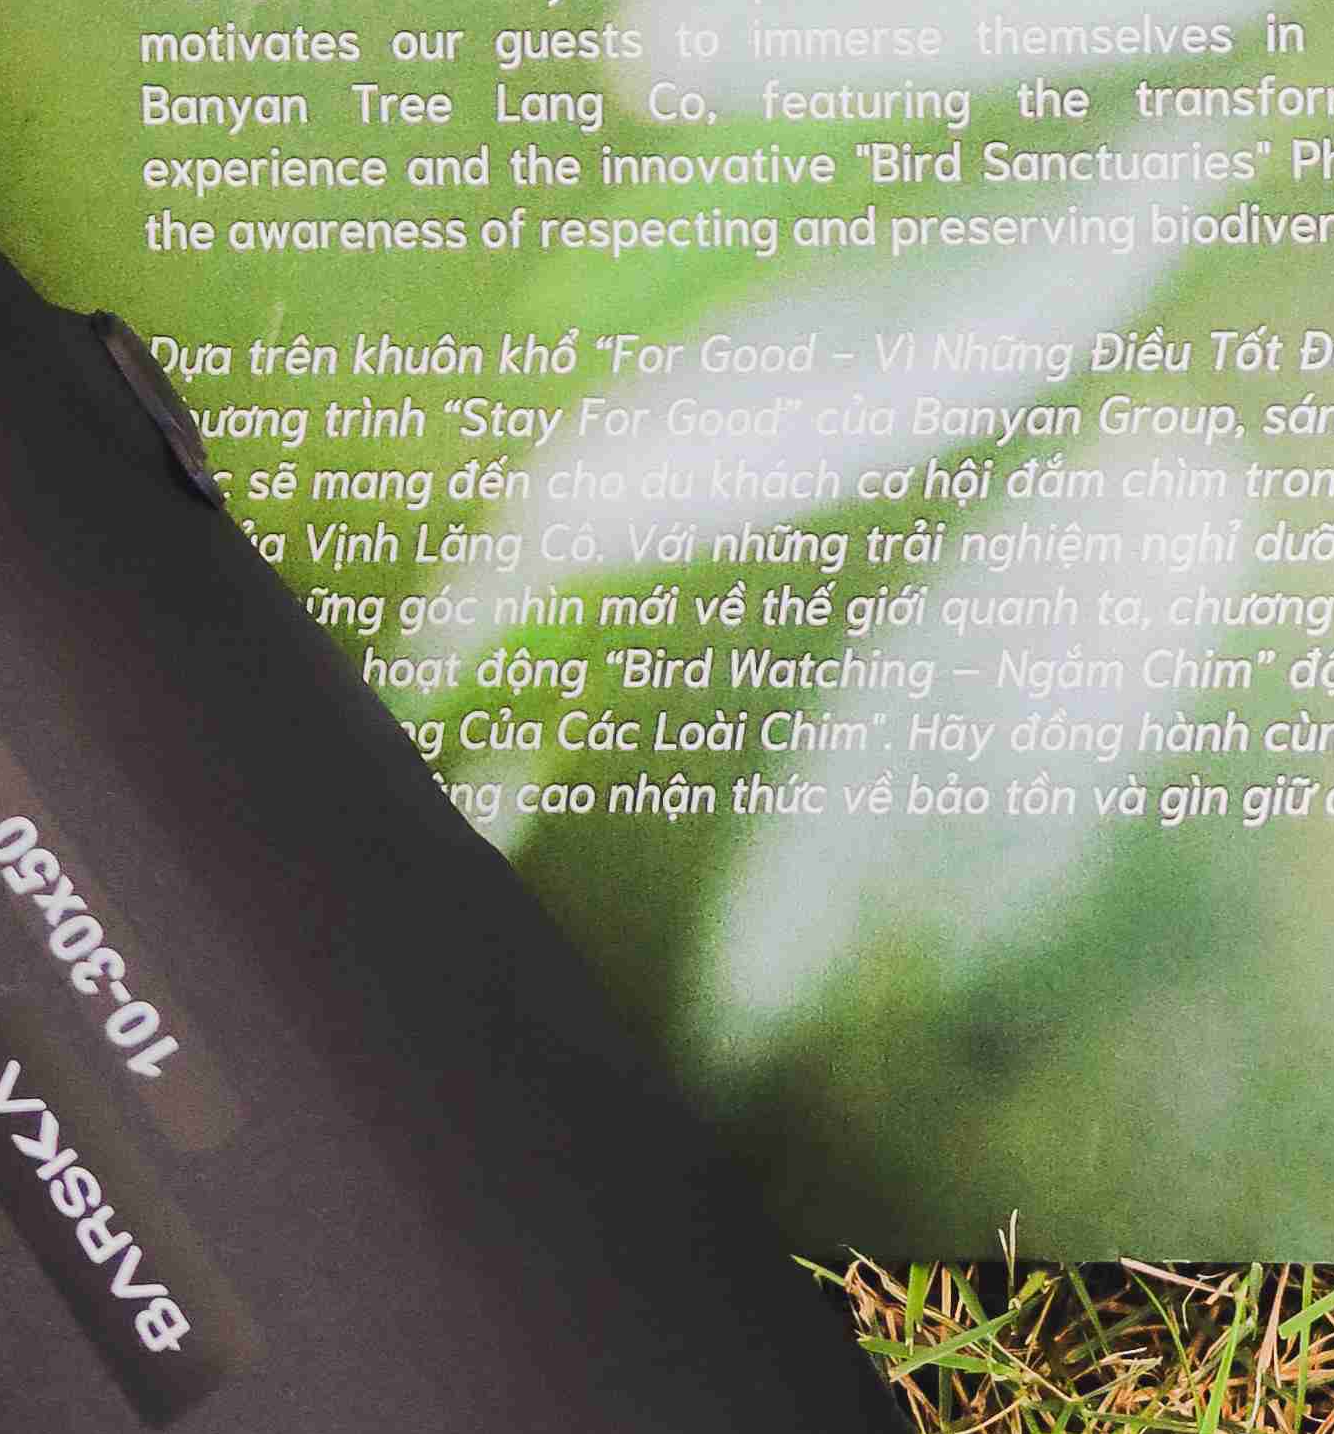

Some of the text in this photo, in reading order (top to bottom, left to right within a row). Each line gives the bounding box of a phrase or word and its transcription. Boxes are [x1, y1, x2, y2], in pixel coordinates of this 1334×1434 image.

[138, 21, 362, 65] motivates
[388, 30, 465, 64] our
[493, 23, 644, 73] guests
[674, 21, 721, 62] to
[745, 14, 944, 61] immerse
[969, 12, 1235, 57] themselves
[1265, 12, 1306, 55] in
[140, 83, 309, 137] Banyan
[349, 82, 454, 127] Tree
[494, 82, 605, 136] Lang
[647, 81, 718, 127] Co,
[761, 77, 972, 135] featuring
[1015, 76, 1091, 121] the
[141, 146, 388, 200] experience
[404, 143, 491, 191] and
[508, 143, 582, 188] the
[600, 142, 837, 187] innovative
[143, 208, 216, 253] the
[227, 218, 469, 254] awareness
[479, 206, 527, 252] of
[538, 205, 780, 262] respecting
[791, 203, 878, 251] and
[889, 204, 1136, 259] preserving
[147, 333, 235, 386] Dựa
[248, 329, 339, 377] trên
[350, 332, 485, 378] khuôn
[497, 328, 581, 378] khổ
[1089, 324, 1193, 376] Điều
[1208, 323, 1284, 376] Tốt
[323, 395, 428, 441] trình
[911, 395, 1083, 450] Banyan
[246, 460, 299, 502] sẽ
[308, 469, 436, 514] mang
[446, 454, 530, 502] đến
[921, 454, 997, 512] hội
[1005, 451, 1106, 500] đắm
[305, 520, 400, 573] Vịnh
[711, 523, 852, 576] những
[865, 517, 947, 566] trải
[597, 582, 682, 629] mới
[692, 578, 748, 630] về
[761, 579, 838, 628] thế
[361, 646, 461, 697] hoạt
[474, 645, 590, 701] động
[457, 706, 544, 752] Của
[555, 708, 642, 753] Các
[652, 708, 750, 754] Loài
[1136, 709, 1251, 754] hành
[515, 782, 597, 816] cao
[606, 771, 718, 825] nhận
[1158, 773, 1230, 829] gìn
[1241, 774, 1322, 829] giữ
